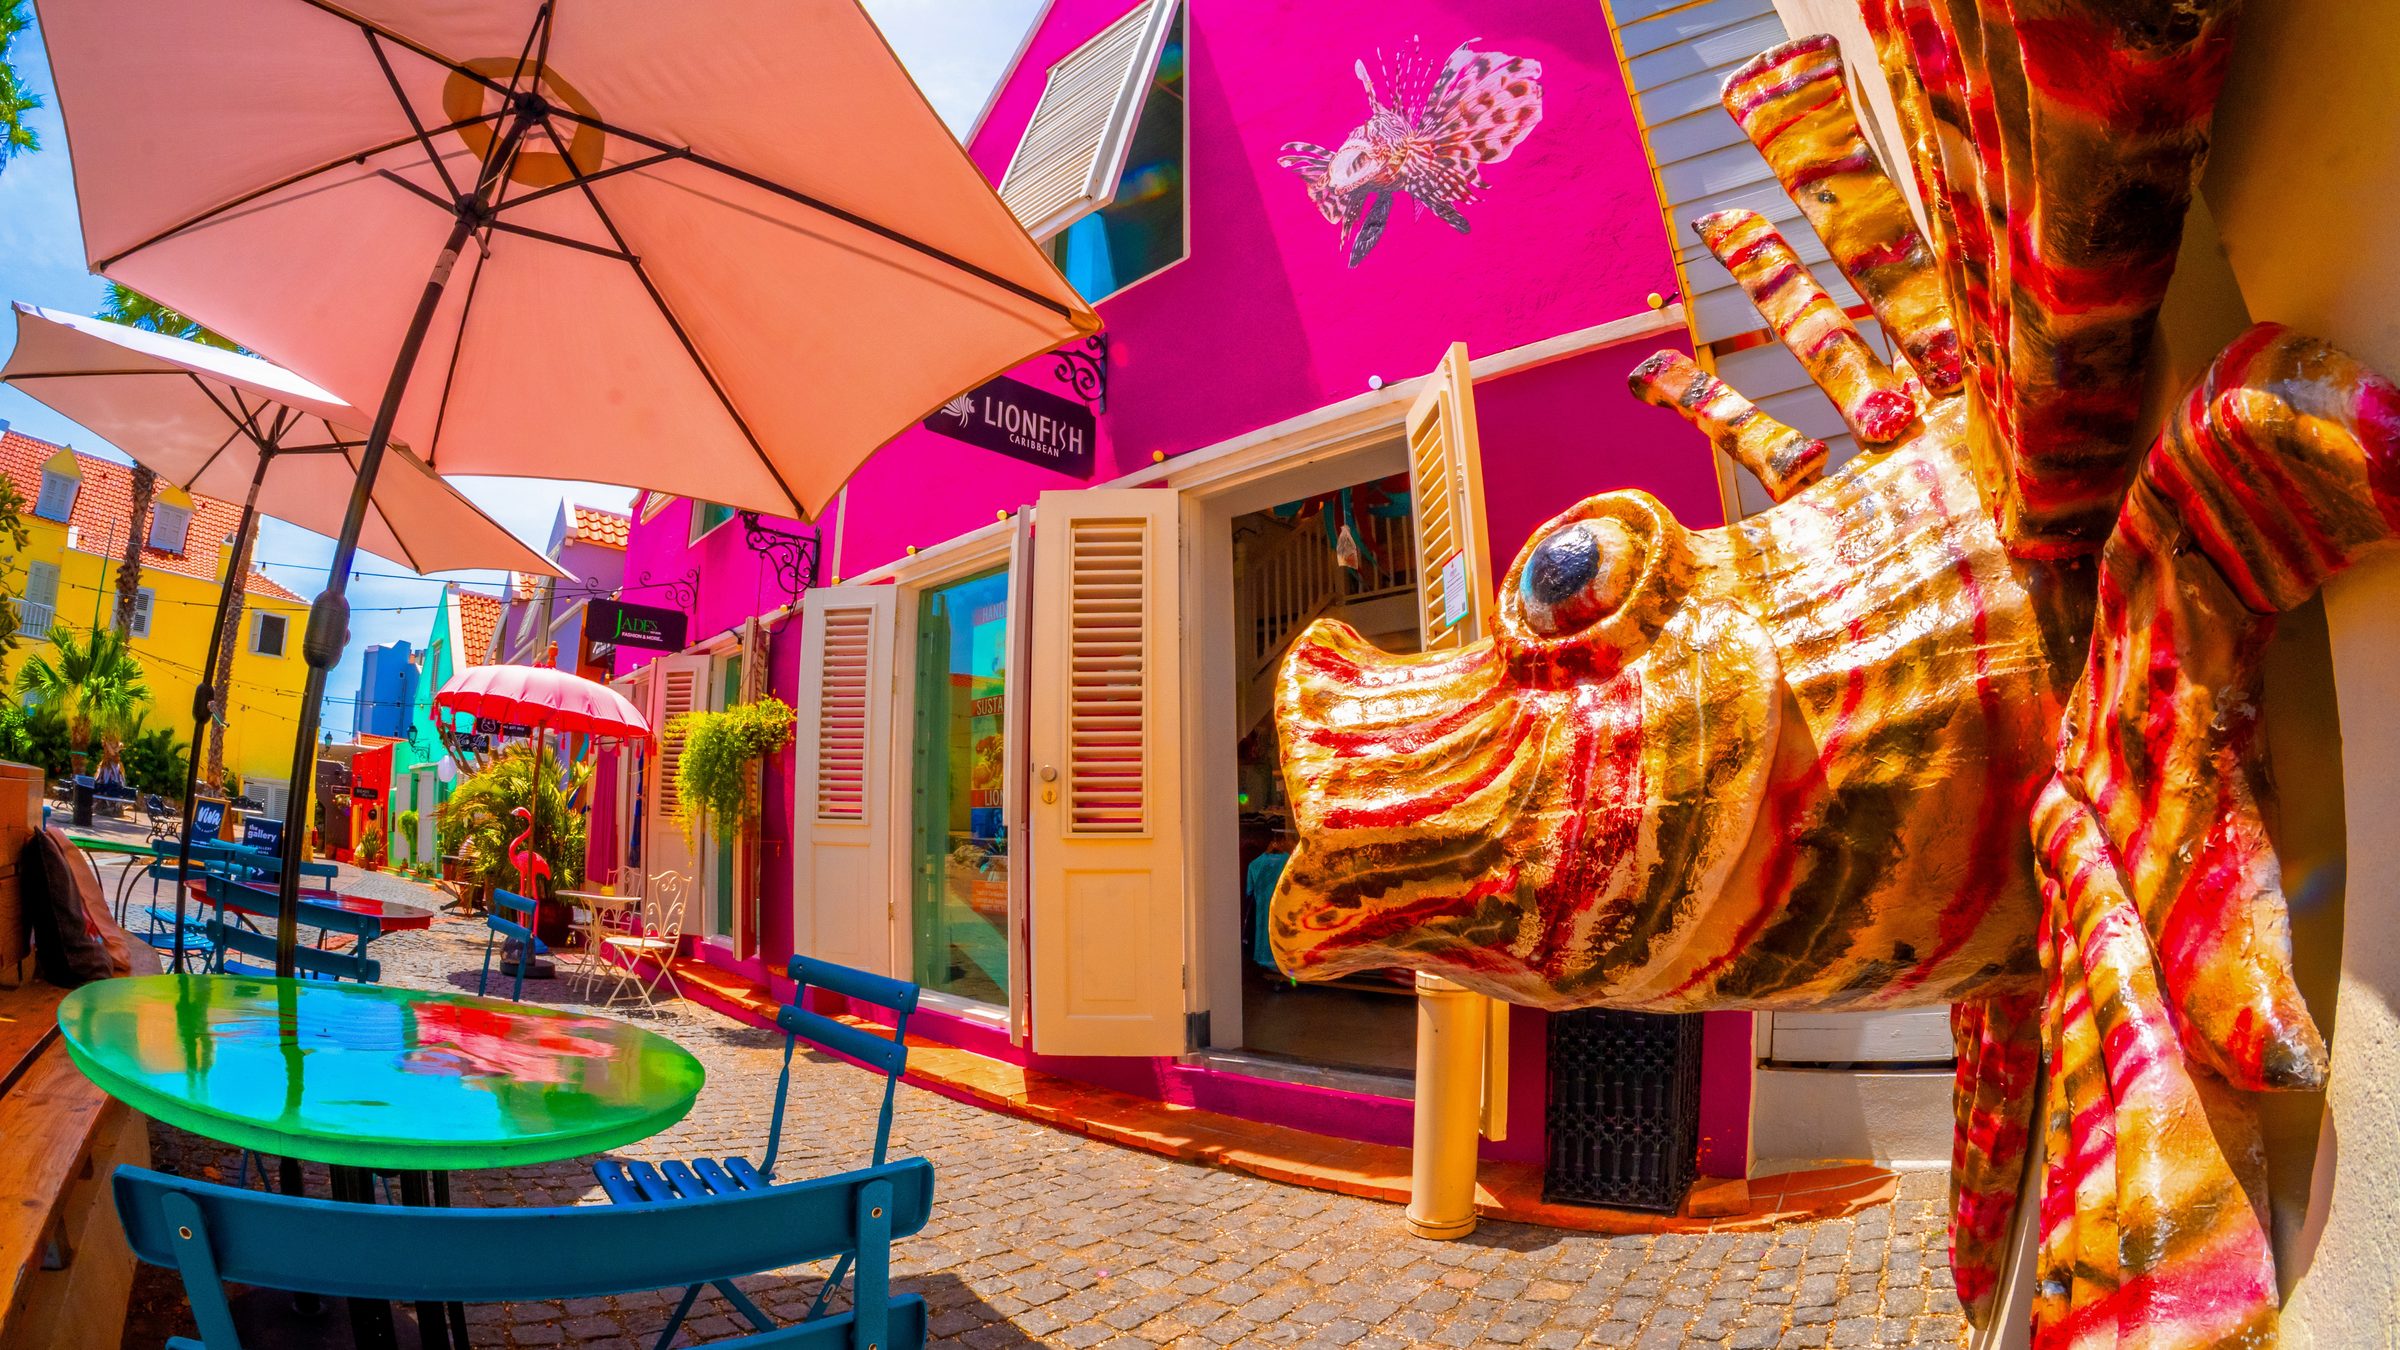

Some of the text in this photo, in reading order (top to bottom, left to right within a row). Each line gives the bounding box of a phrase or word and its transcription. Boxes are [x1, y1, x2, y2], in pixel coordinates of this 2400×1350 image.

[984, 396, 1083, 455] LIONFISH
[1009, 433, 1060, 458] CARIBBEAN
[621, 631, 642, 639] FASHION
[249, 824, 259, 833] the
[247, 829, 277, 843] gallery
